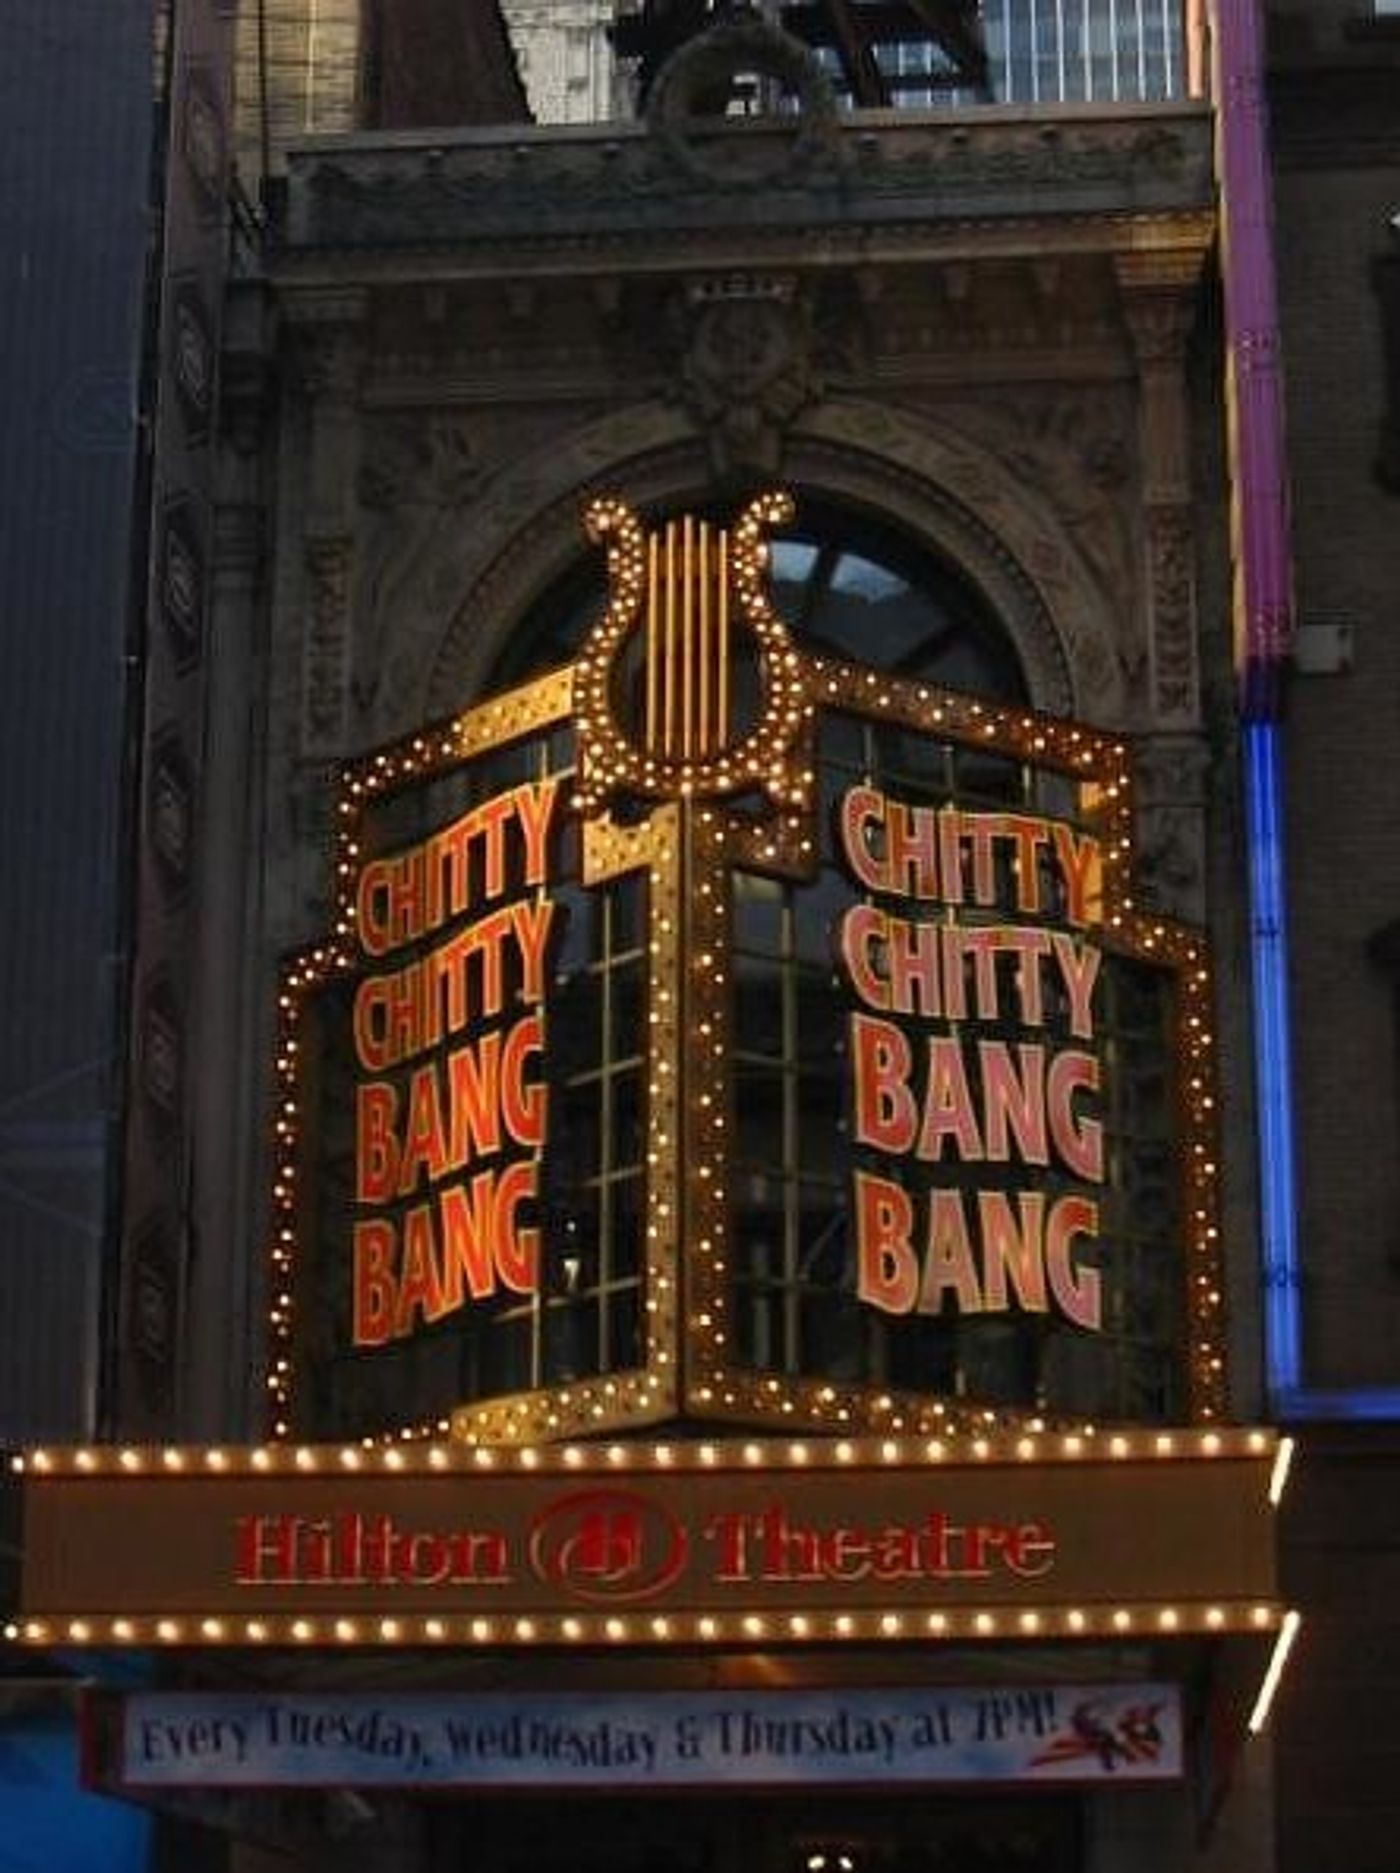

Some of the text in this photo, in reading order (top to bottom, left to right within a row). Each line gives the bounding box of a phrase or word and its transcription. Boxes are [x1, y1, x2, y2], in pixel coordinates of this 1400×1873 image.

[359, 781, 558, 956] CHITTY
[841, 786, 1101, 928] CHITTY
[353, 900, 552, 1071] CHITTY
[842, 904, 1100, 1039] CHITTY
[356, 1015, 547, 1202] BANG
[852, 1012, 1104, 1182] BANG
[353, 1161, 540, 1347] BANG
[854, 1171, 1100, 1332] BANG
[235, 1513, 511, 1586] Hilton
[703, 1507, 1057, 1585] Theatre
[140, 1714, 250, 1763] Every
[713, 1707, 898, 1763] Thursday
[909, 1702, 953, 1749] at
